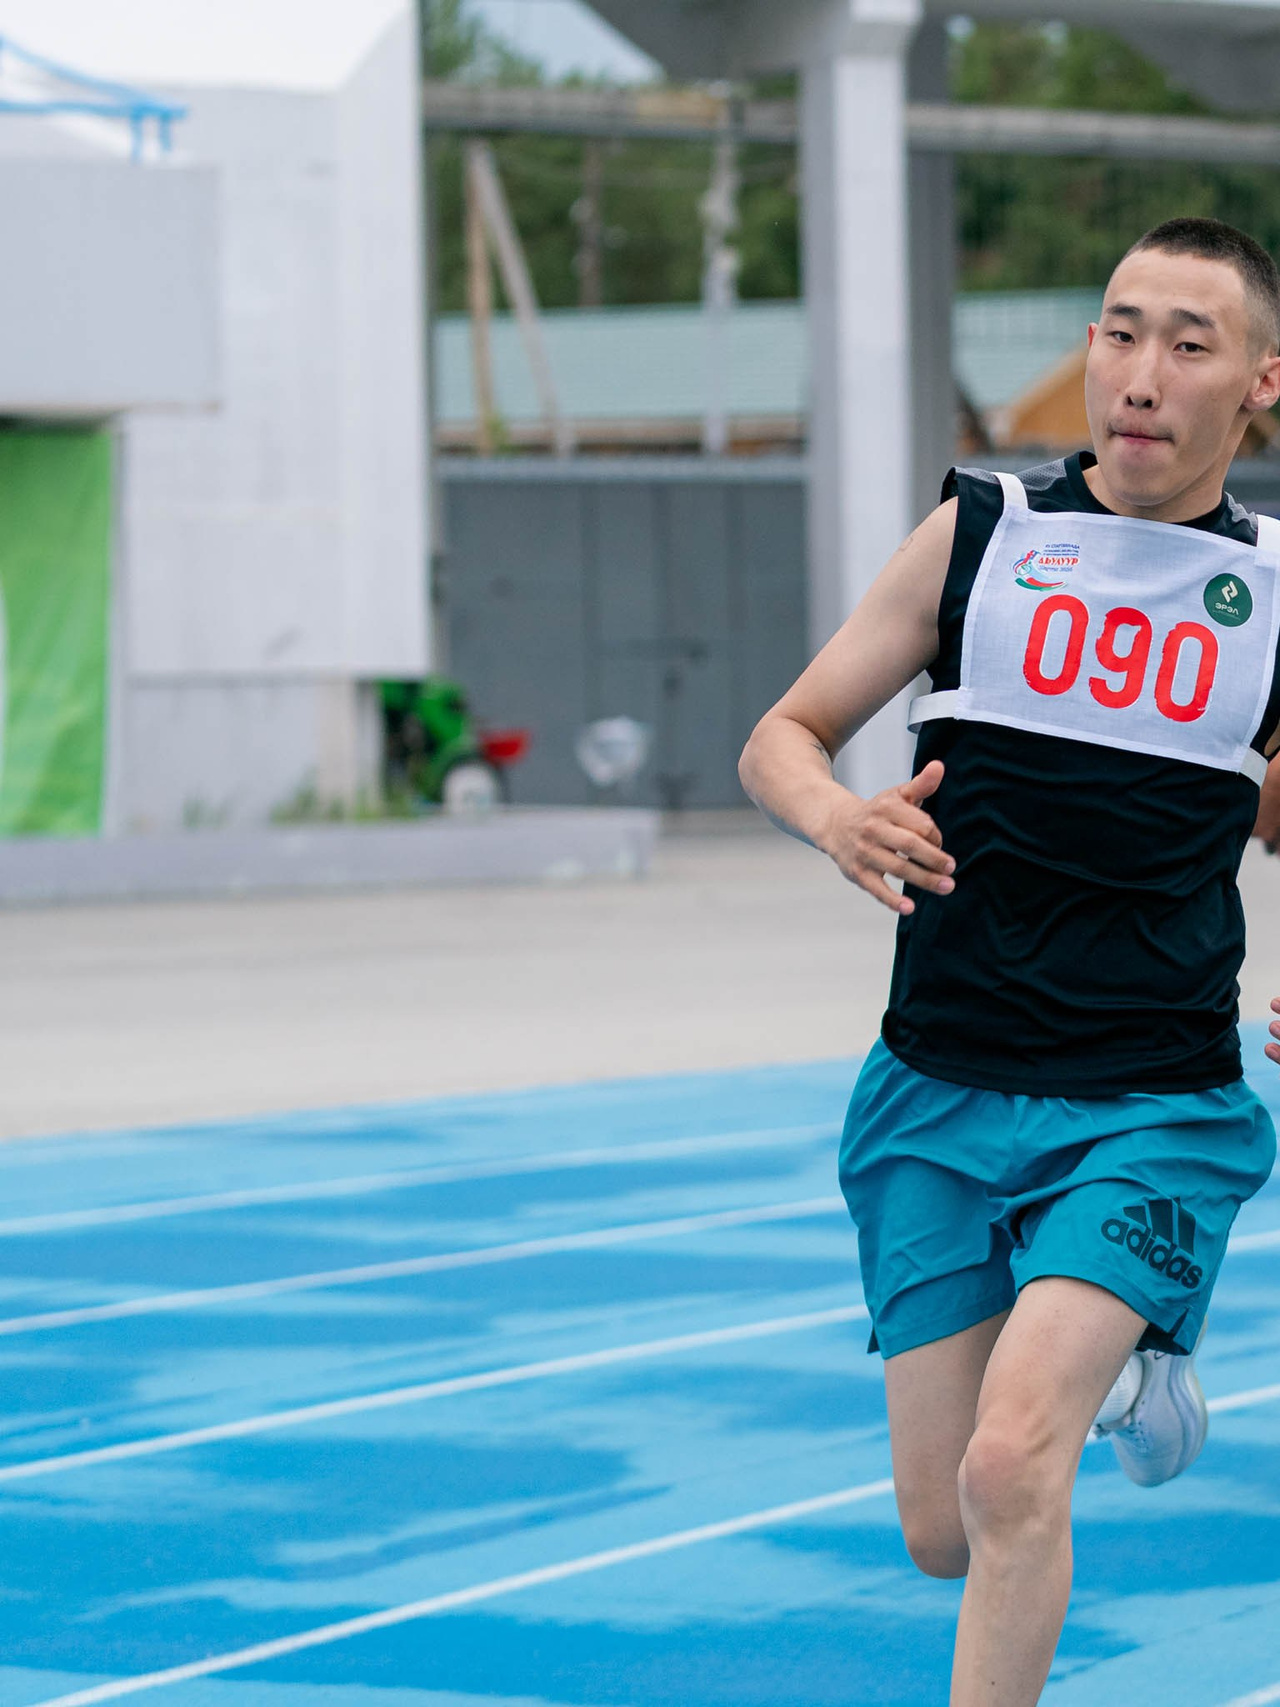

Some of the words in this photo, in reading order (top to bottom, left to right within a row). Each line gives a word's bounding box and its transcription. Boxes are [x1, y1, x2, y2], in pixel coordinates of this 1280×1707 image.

[1214, 602, 1239, 616] ЭРЭЛ
[1022, 594, 1219, 723] 090
[1101, 1218, 1203, 1289] adidas
